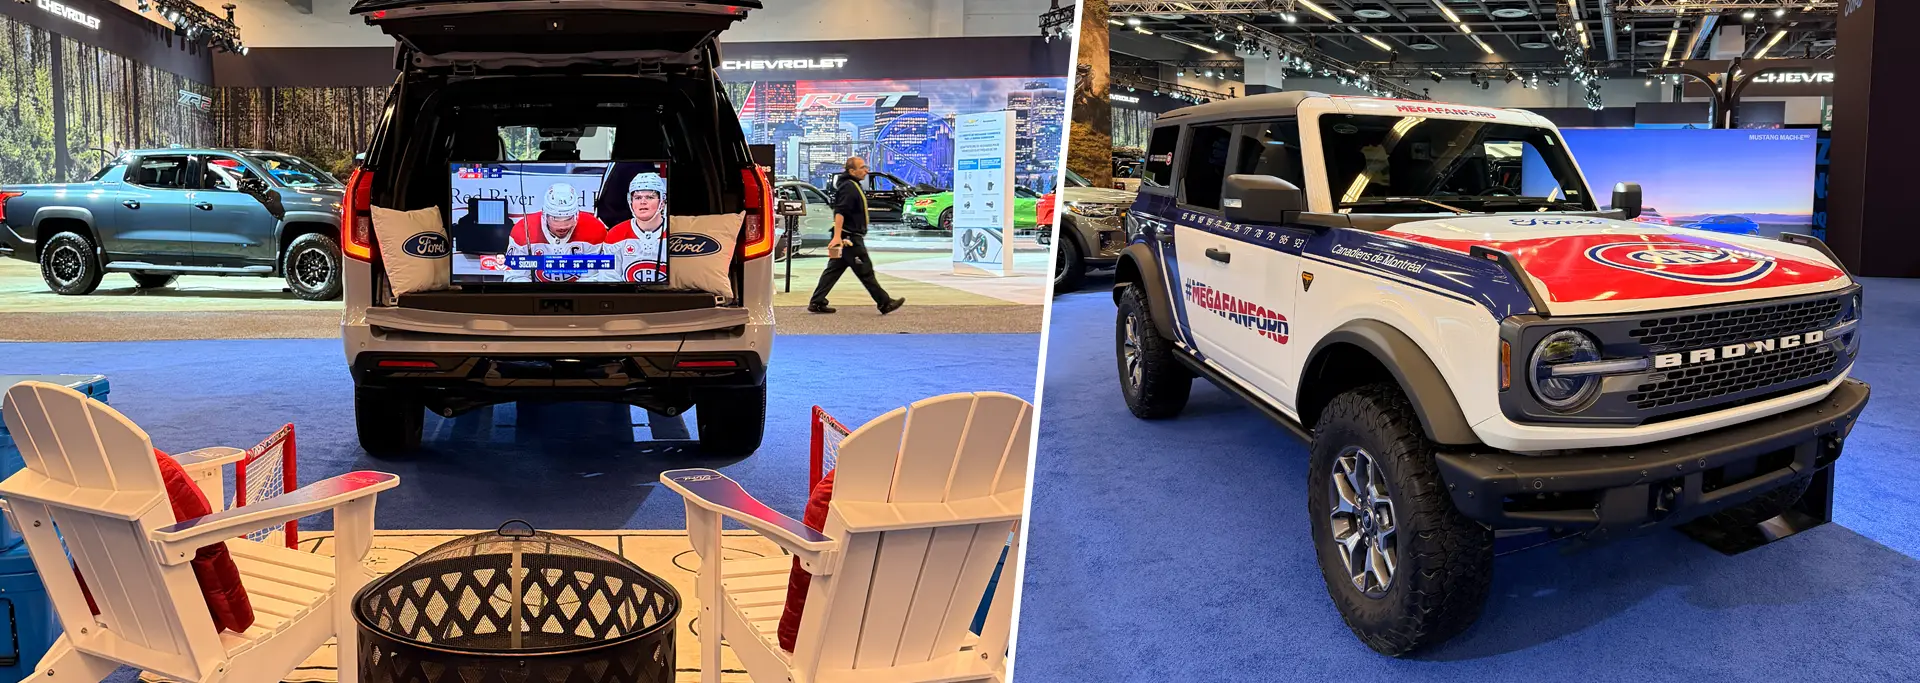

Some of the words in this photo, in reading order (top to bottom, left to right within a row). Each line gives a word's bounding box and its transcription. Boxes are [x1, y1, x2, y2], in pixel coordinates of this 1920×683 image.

[37, 0, 100, 30] CHEVROLET
[722, 58, 848, 70] CHEVROLET
[795, 90, 920, 109] RST
[1395, 104, 1497, 119] MEGAFANFORD
[417, 235, 446, 254] Ford
[669, 236, 707, 253] Ford
[1331, 244, 1371, 261] Canadiens
[1370, 252, 1385, 263] de
[1382, 252, 1427, 274] Montréal
[1185, 278, 1289, 345] #MEGAFANFORD
[1655, 330, 1825, 369] BRONCO
